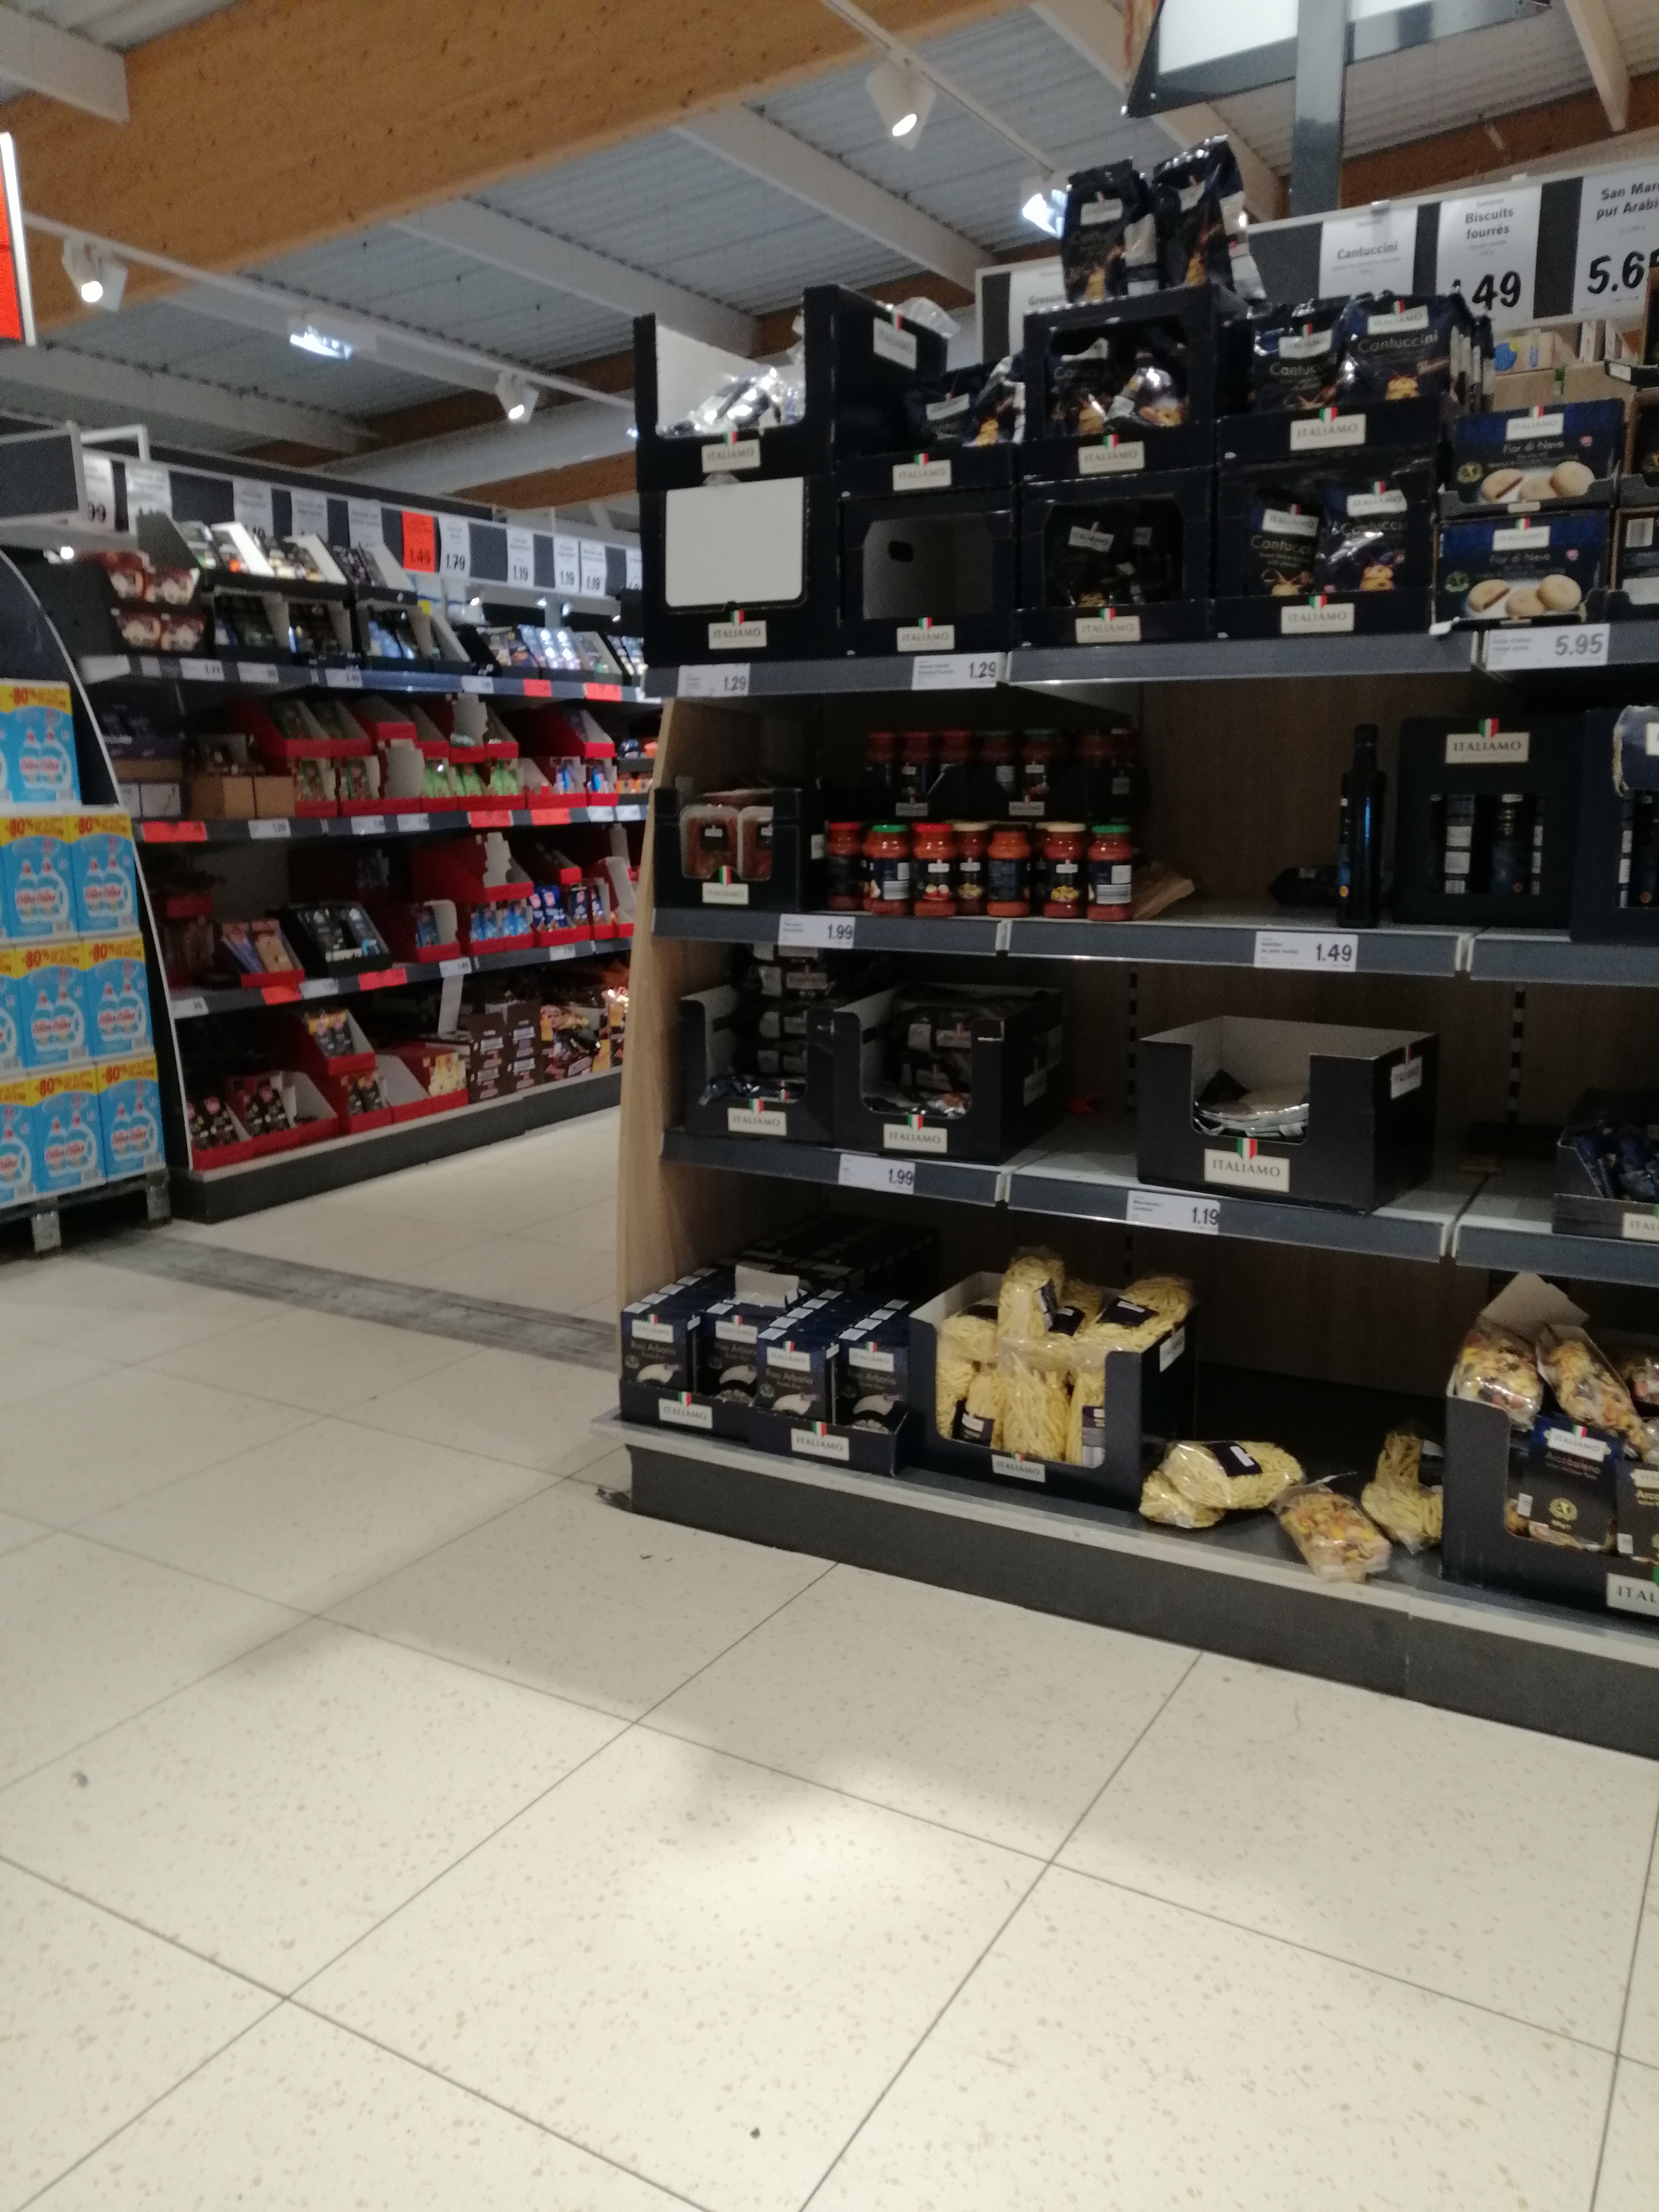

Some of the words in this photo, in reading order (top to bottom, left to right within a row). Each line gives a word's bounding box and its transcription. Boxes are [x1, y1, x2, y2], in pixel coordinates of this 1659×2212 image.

[1601, 188, 1626, 201] San
[1465, 207, 1514, 224] Biscuits
[1596, 207, 1618, 221] pur
[1467, 222, 1510, 239] fourrés
[1336, 240, 1398, 260] Cantuccini
[1297, 423, 1359, 438] ITALIAMO
[707, 447, 755, 461] ITALIAMO
[1084, 450, 1138, 462] ITALIAMO
[898, 467, 946, 480] ITALIAMO
[1288, 610, 1347, 623] ITALIAMO
[713, 628, 761, 639] ITALIAMO
[1081, 623, 1135, 633] ITALIAMO
[902, 632, 949, 642] ITALIAMO
[1555, 633, 1604, 656] 5.95
[970, 661, 996, 679] 1.29
[724, 675, 746, 692] 1.29
[1453, 741, 1521, 752] ITALIAMO
[828, 924, 853, 940] 1.99
[1317, 944, 1352, 962] 1.49
[732, 1115, 781, 1127] ITALIAMO
[889, 1131, 941, 1144] ITALIAMO
[1213, 1159, 1281, 1177] ITALIAMO
[889, 1168, 914, 1185] 1.99
[1192, 1207, 1219, 1226] 1.19
[663, 1405, 707, 1421] ITALIAMO
[796, 1436, 844, 1452] ITALIAMO
[996, 1461, 1040, 1476] ITALIAMO
[1618, 1585, 1658, 1605] ITAL
